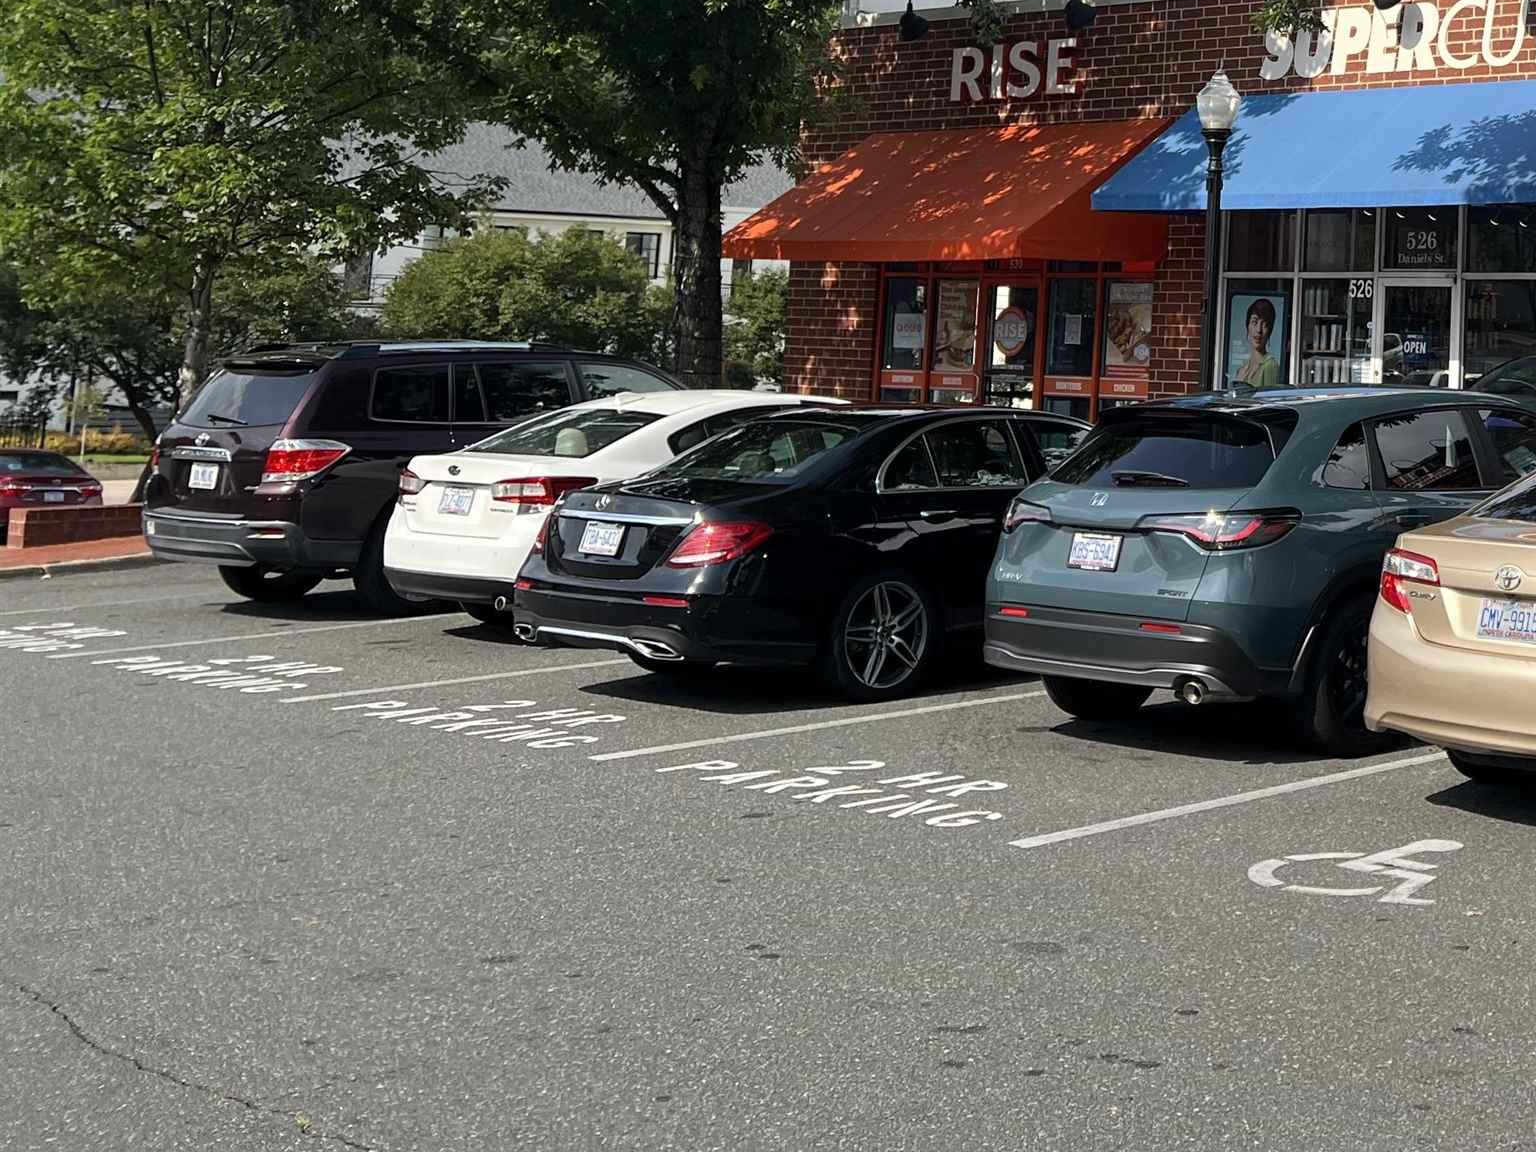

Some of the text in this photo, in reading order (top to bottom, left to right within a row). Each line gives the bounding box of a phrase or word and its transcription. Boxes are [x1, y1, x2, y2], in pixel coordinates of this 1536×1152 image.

[950, 37, 1077, 101] RISE
[1406, 231, 1437, 250] 526
[1348, 279, 1373, 298] 526
[995, 323, 1026, 341] RISE
[1403, 341, 1427, 354] OPEN
[91, 656, 308, 693] PARKING
[332, 700, 599, 748] PARKING
[515, 708, 626, 728] HR
[804, 760, 1009, 798] 2 HR
[656, 760, 1003, 827] PARKING
